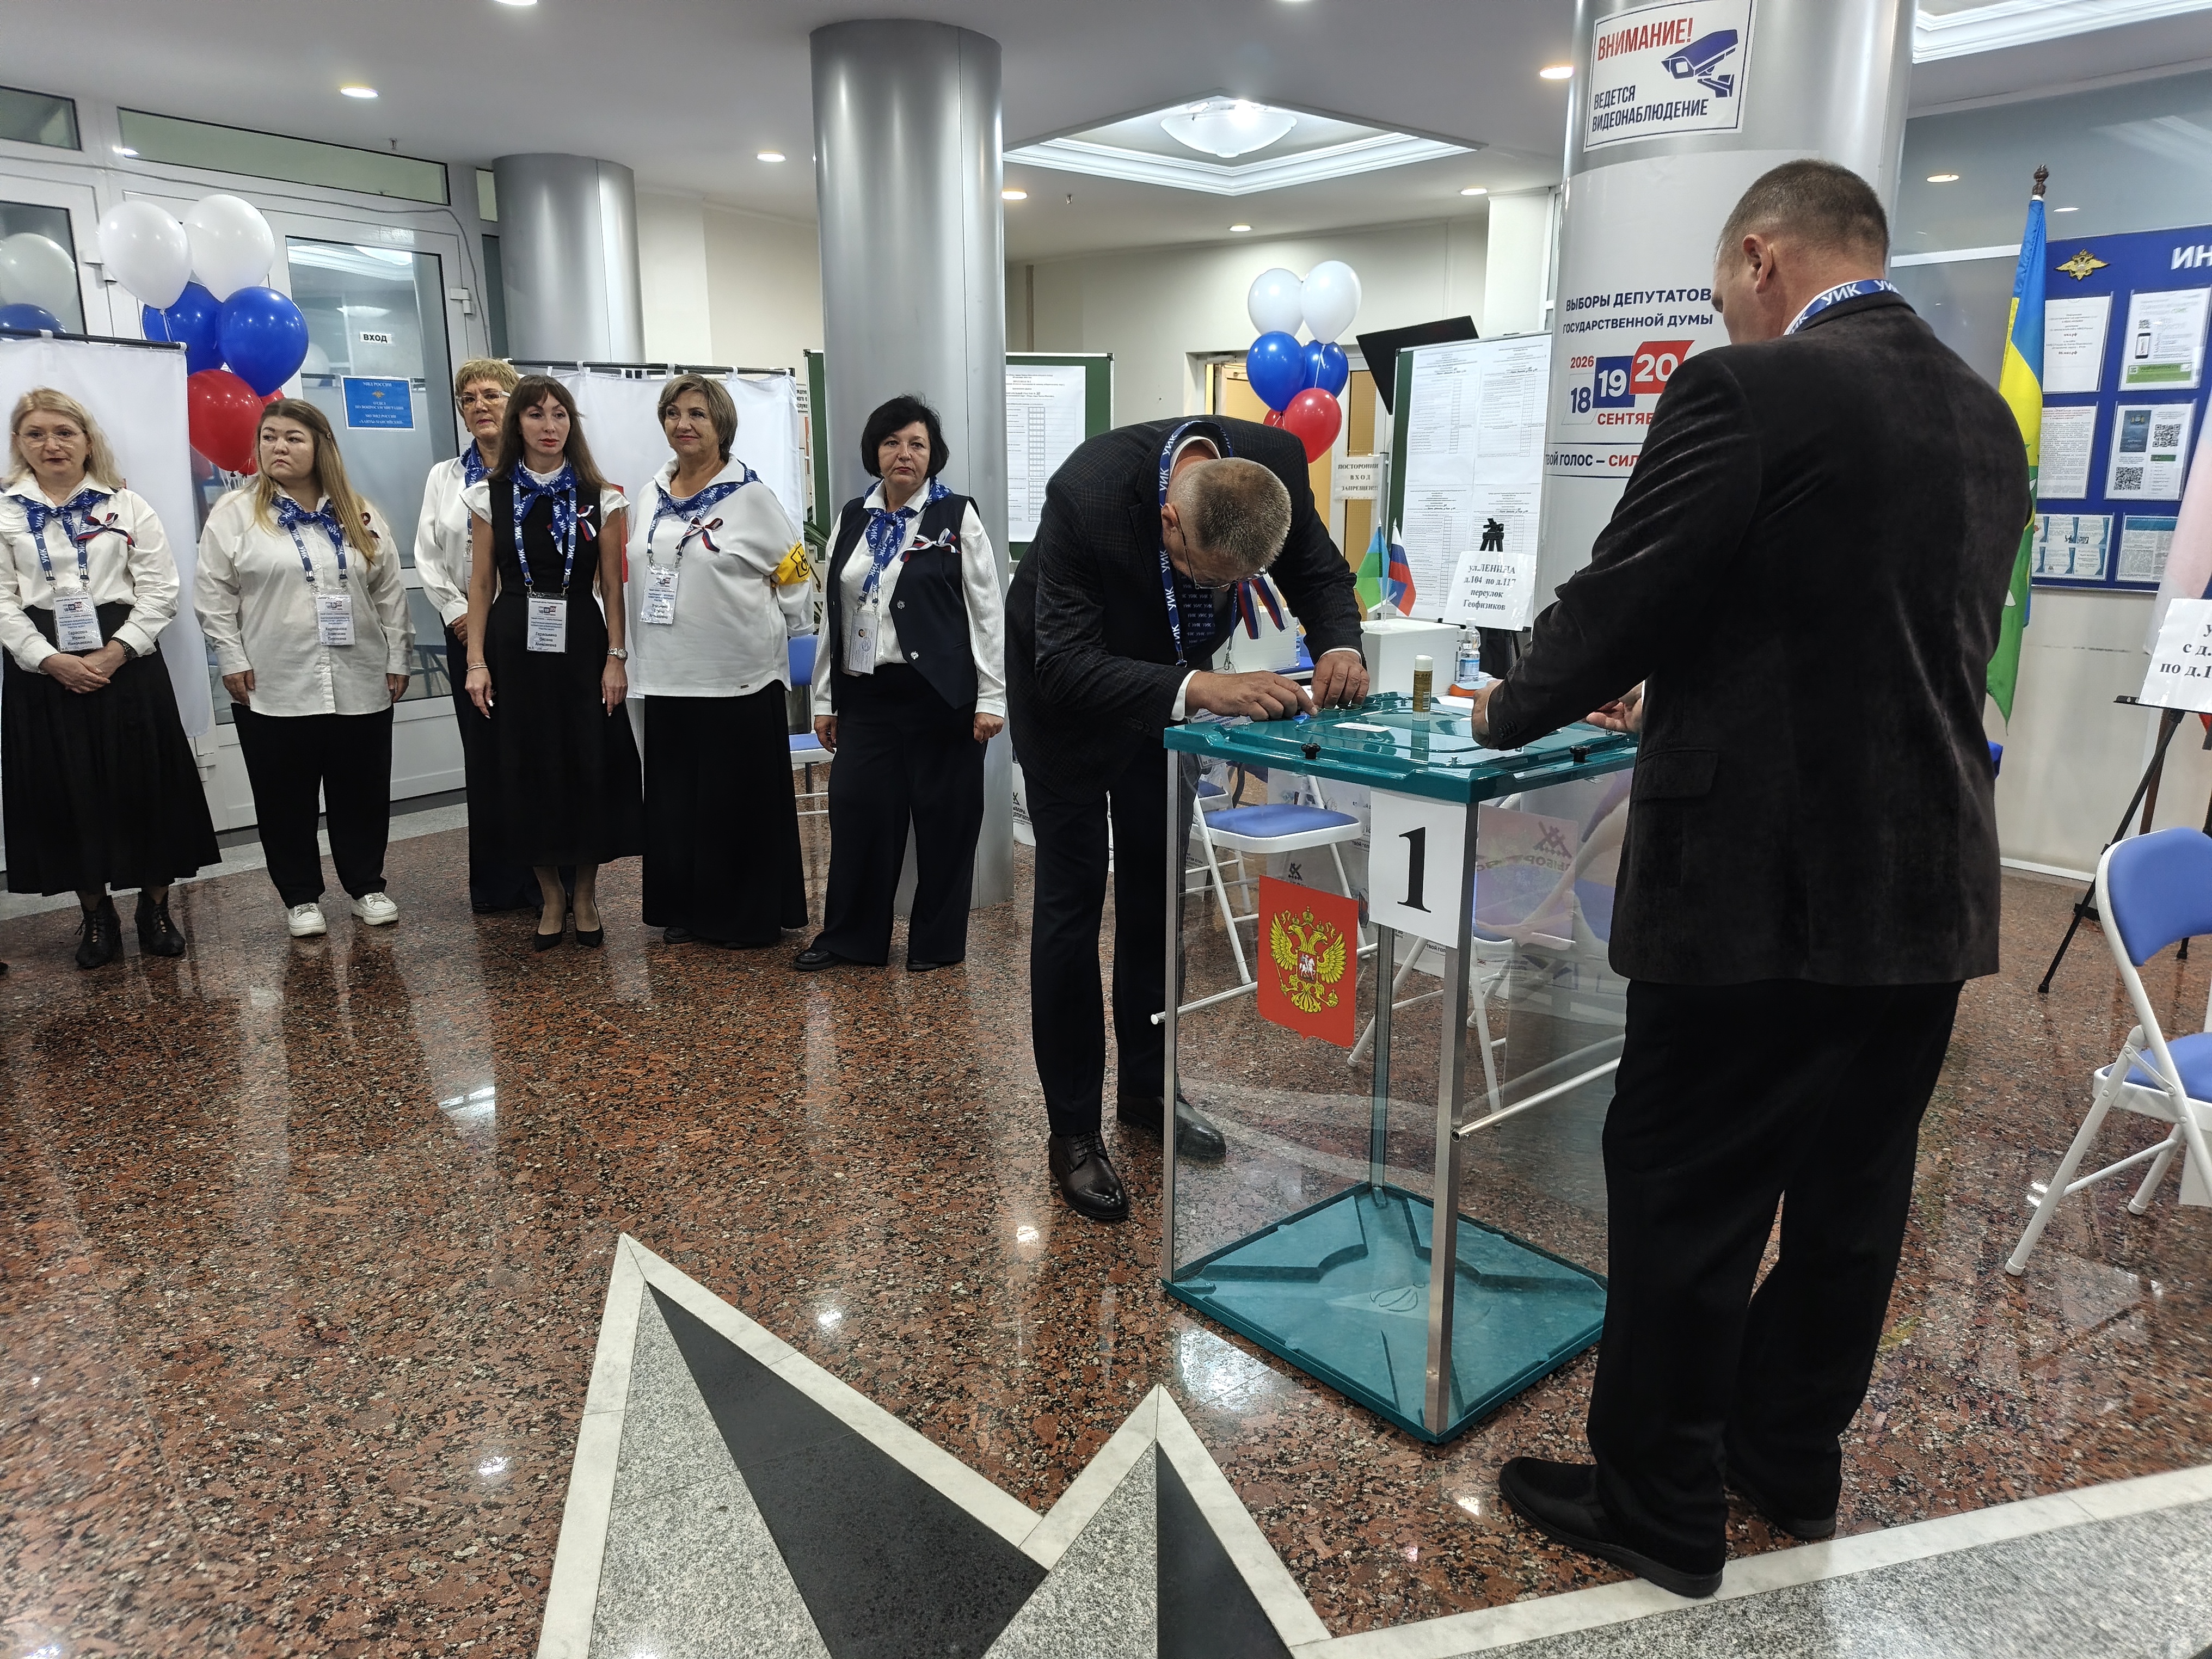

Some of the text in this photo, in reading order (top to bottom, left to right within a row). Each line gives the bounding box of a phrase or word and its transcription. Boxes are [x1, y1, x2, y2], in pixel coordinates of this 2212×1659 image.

[1597, 18, 1693, 61] ВНИМАНИЕ!
[1594, 85, 1636, 110] ВЕДЕТСЯ
[1592, 99, 1709, 132] ВИДЕОНАБЛЮДЕНИЕ
[1565, 288, 1712, 312] ВЫБОРЫ ДЕПУТАТОВ
[1821, 283, 1862, 306] УИК
[1563, 313, 1713, 334] ГОСУДАРСТВЕННОЙ ДУМЫ
[363, 334, 388, 343] ВХОД
[1570, 355, 1594, 369] 2026
[1634, 353, 1679, 382] 20
[1598, 369, 1627, 398] 19
[1570, 386, 1591, 414] 18
[1597, 413, 1652, 425] СЕНТЯБ
[1163, 434, 1178, 456] УИК
[1559, 454, 1593, 466] ГОЛОС
[1608, 454, 1639, 466] СИЛ
[1159, 467, 1169, 491] УИК
[707, 487, 718, 500] УИК
[553, 505, 562, 519] УИК
[697, 504, 709, 519] УИК
[35, 512, 45, 529] УИК
[557, 519, 567, 533] ИК
[291, 529, 301, 541] УИК
[39, 548, 50, 564] УИК
[299, 546, 309, 559] УИК
[518, 549, 526, 563] УИК
[567, 545, 575, 560] УИК
[1160, 550, 1170, 573] УИК
[869, 562, 880, 577] УИК
[1464, 575, 1482, 583] д.104
[1165, 586, 1176, 611] УИК
[1471, 589, 1504, 599] переулок
[1463, 599, 1506, 610] Геофизиков
[1172, 624, 1180, 644] ИК
[2183, 643, 2192, 653] с
[2160, 663, 2181, 674] по
[1397, 826, 1431, 913] 1
